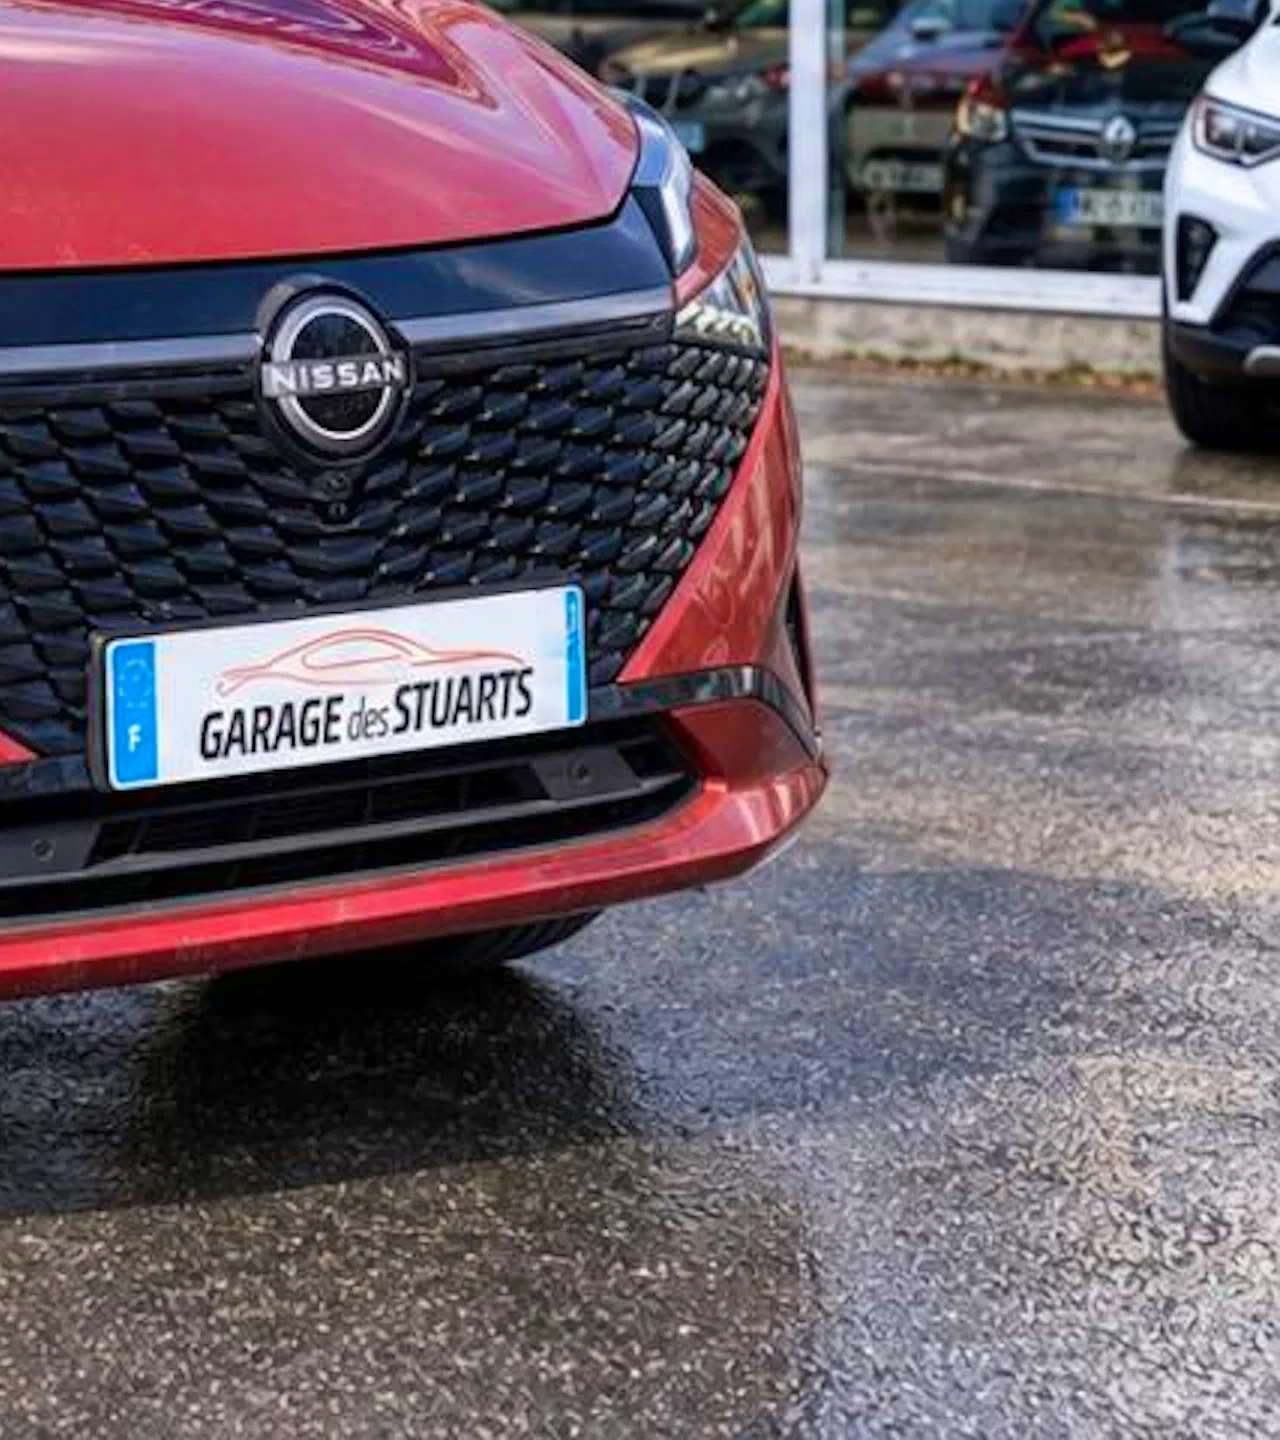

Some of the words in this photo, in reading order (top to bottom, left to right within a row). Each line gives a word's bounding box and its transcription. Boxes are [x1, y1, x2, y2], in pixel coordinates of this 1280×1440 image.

[271, 357, 403, 392] NISSAN
[200, 694, 340, 760] GARAGE
[347, 693, 390, 740] des
[392, 666, 534, 735] STUARTS
[128, 725, 142, 751] F
